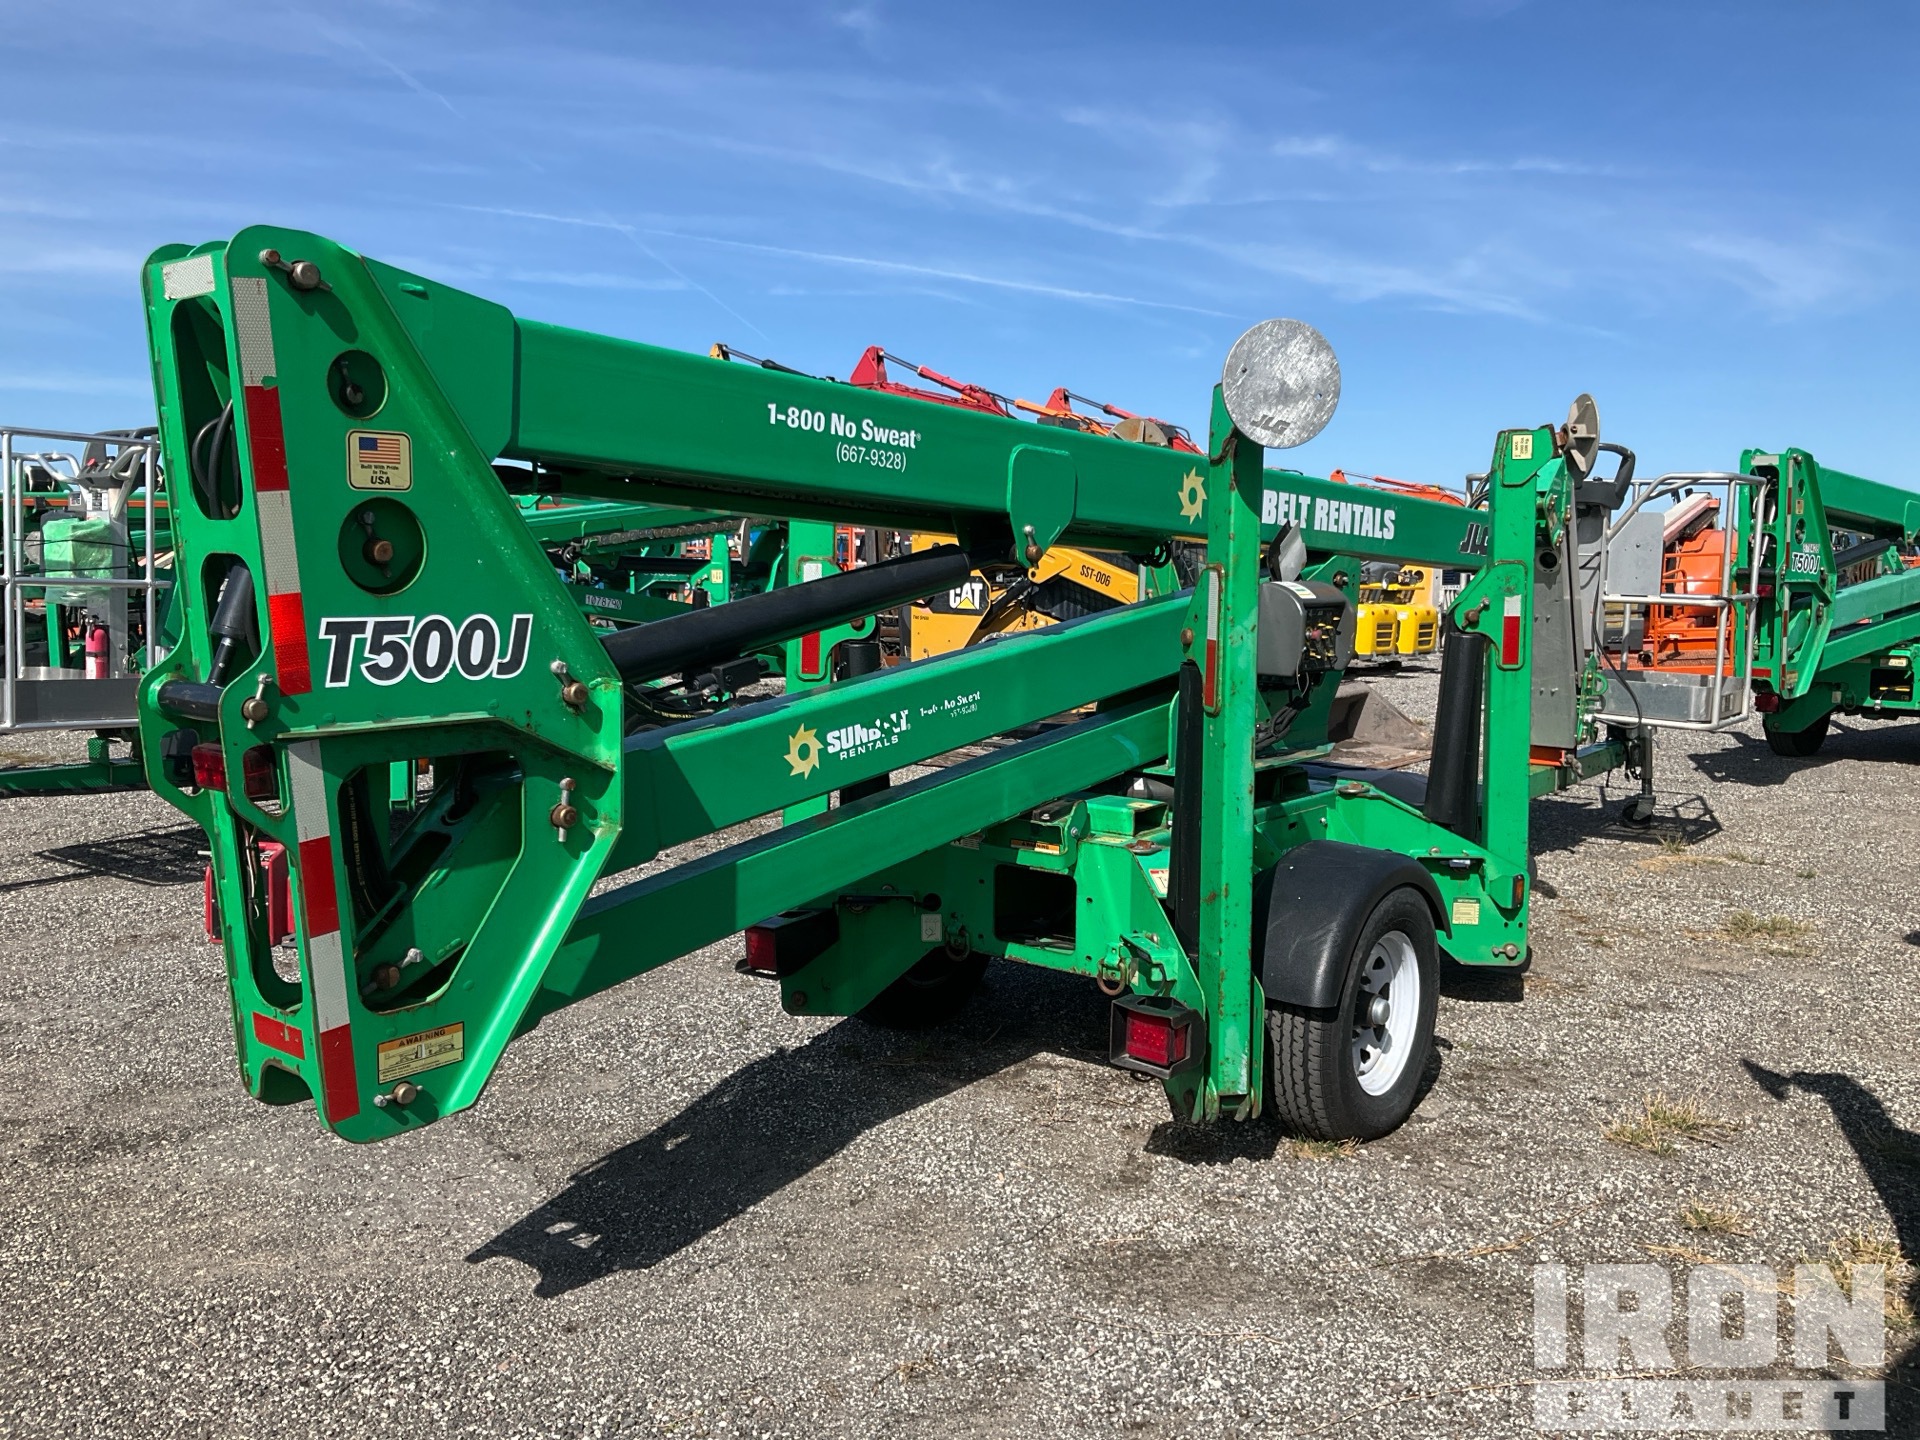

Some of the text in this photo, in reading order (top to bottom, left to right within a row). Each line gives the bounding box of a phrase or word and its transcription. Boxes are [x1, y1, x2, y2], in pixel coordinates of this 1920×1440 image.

[768, 403, 825, 432] 1-800
[831, 413, 857, 438] No
[1250, 414, 1291, 435] JLG
[836, 442, 906, 473] (667-9328)
[370, 475, 391, 485] USA
[1314, 498, 1396, 540] RENTALS
[1080, 564, 1111, 587] SST-006
[1792, 552, 1820, 575] T500J
[950, 582, 983, 610] CAT
[319, 613, 533, 688] T500J
[839, 735, 899, 760] RENTALS
